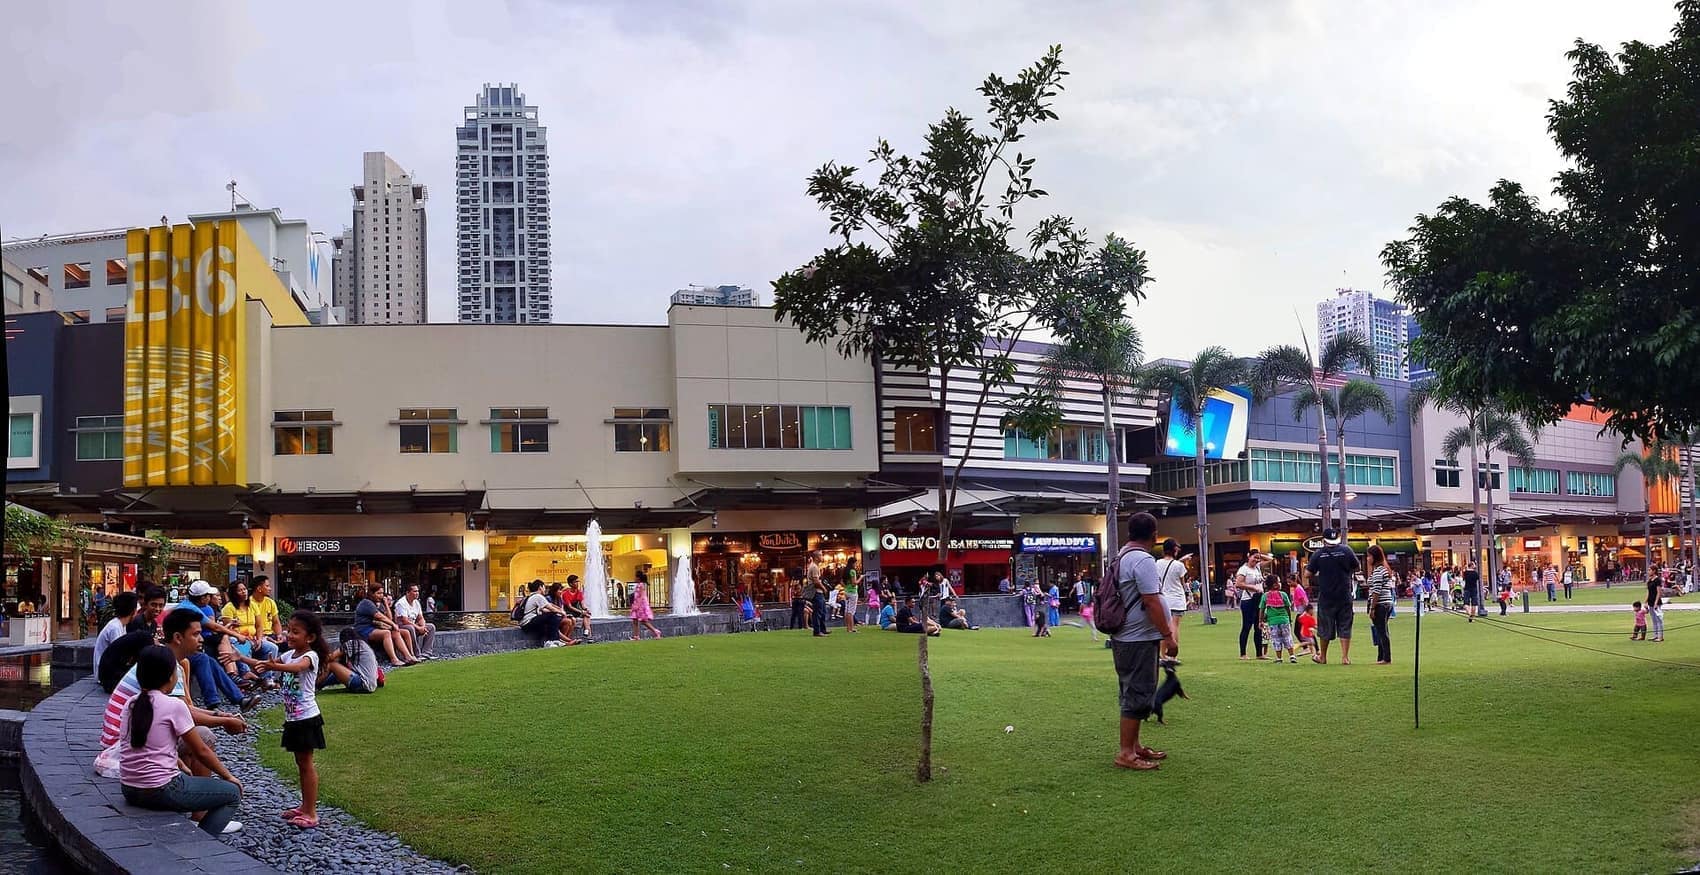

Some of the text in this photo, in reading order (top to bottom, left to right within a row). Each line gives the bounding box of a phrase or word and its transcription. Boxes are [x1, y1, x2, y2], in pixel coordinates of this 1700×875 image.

[298, 540, 340, 552] HEROES
[925, 537, 978, 549] OEANS
[1022, 537, 1095, 546] CLAWDADDY'S
